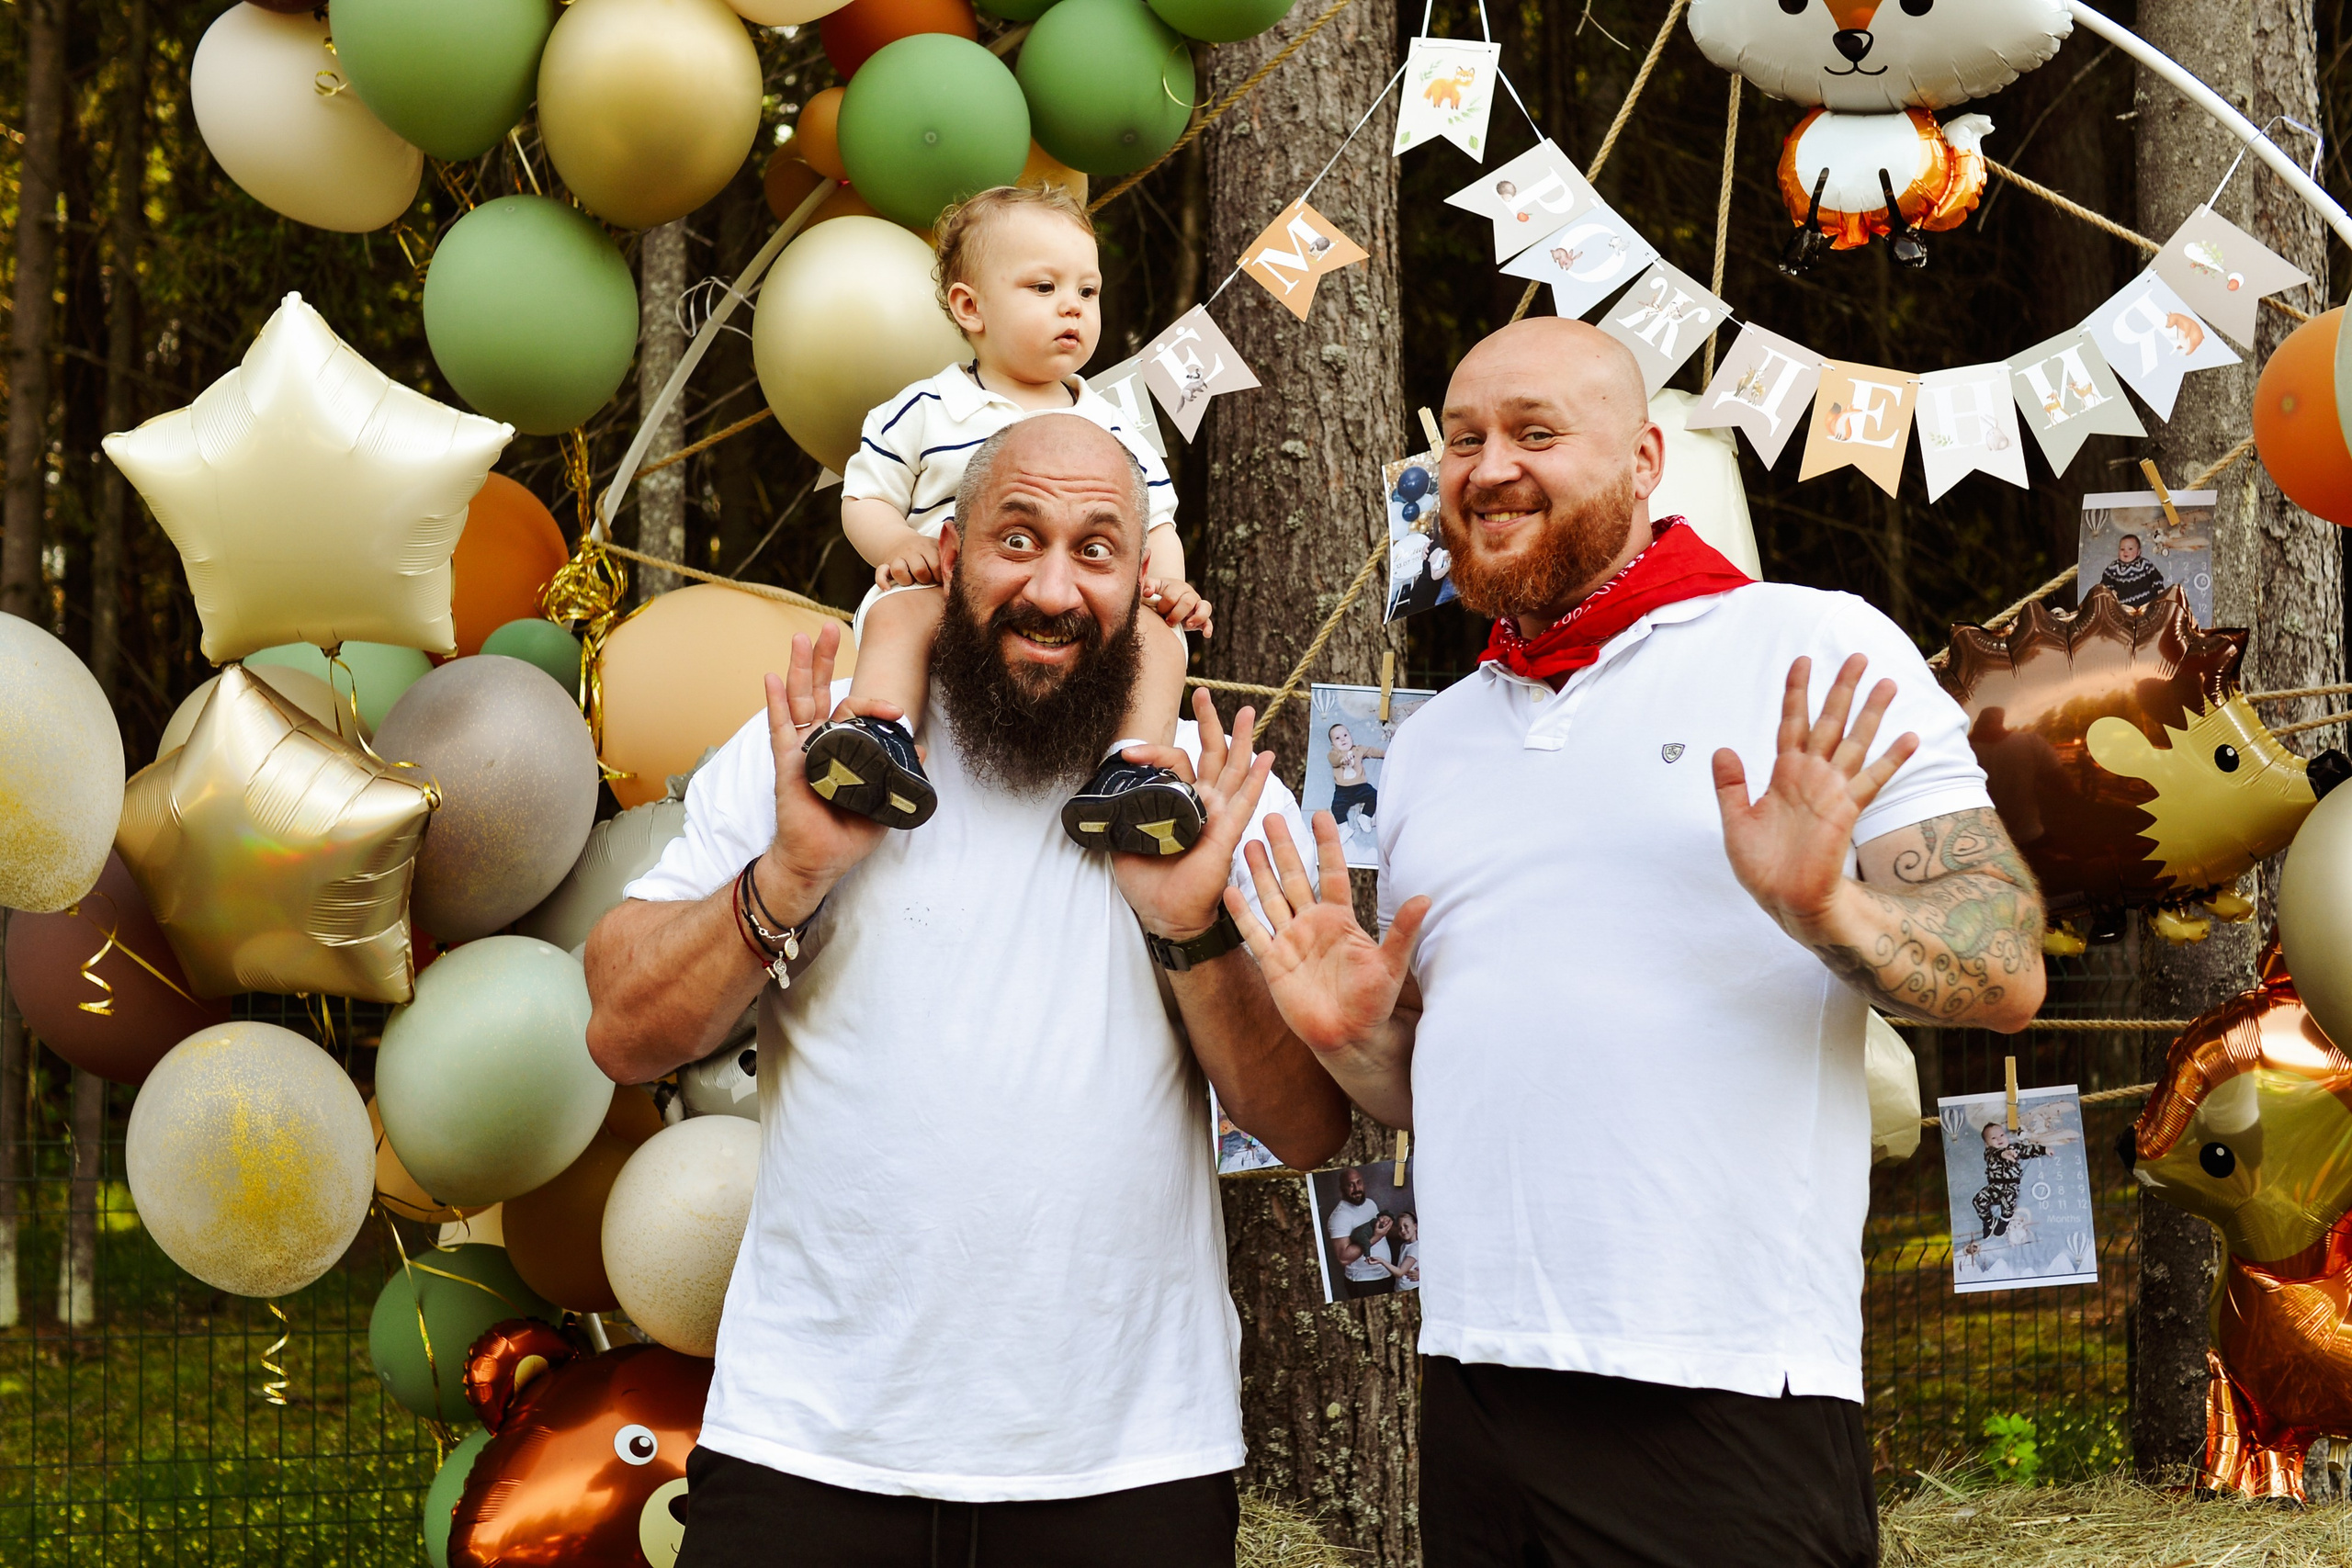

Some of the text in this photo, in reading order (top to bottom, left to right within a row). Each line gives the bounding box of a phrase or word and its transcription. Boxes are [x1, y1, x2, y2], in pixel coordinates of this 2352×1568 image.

[2183, 561, 2189, 570] 2
[2201, 561, 2207, 570] 3
[2199, 604, 2207, 613] 12
[2054, 1156, 2061, 1167] 2
[2075, 1155, 2082, 1165] 3
[2038, 1170, 2084, 1181] 4 5 6
[2058, 1185, 2065, 1195] 8
[2078, 1184, 2085, 1194] 9
[2058, 1200, 2067, 1210] 11
[2077, 1199, 2087, 1210] 12
[2046, 1213, 2082, 1224] Months
